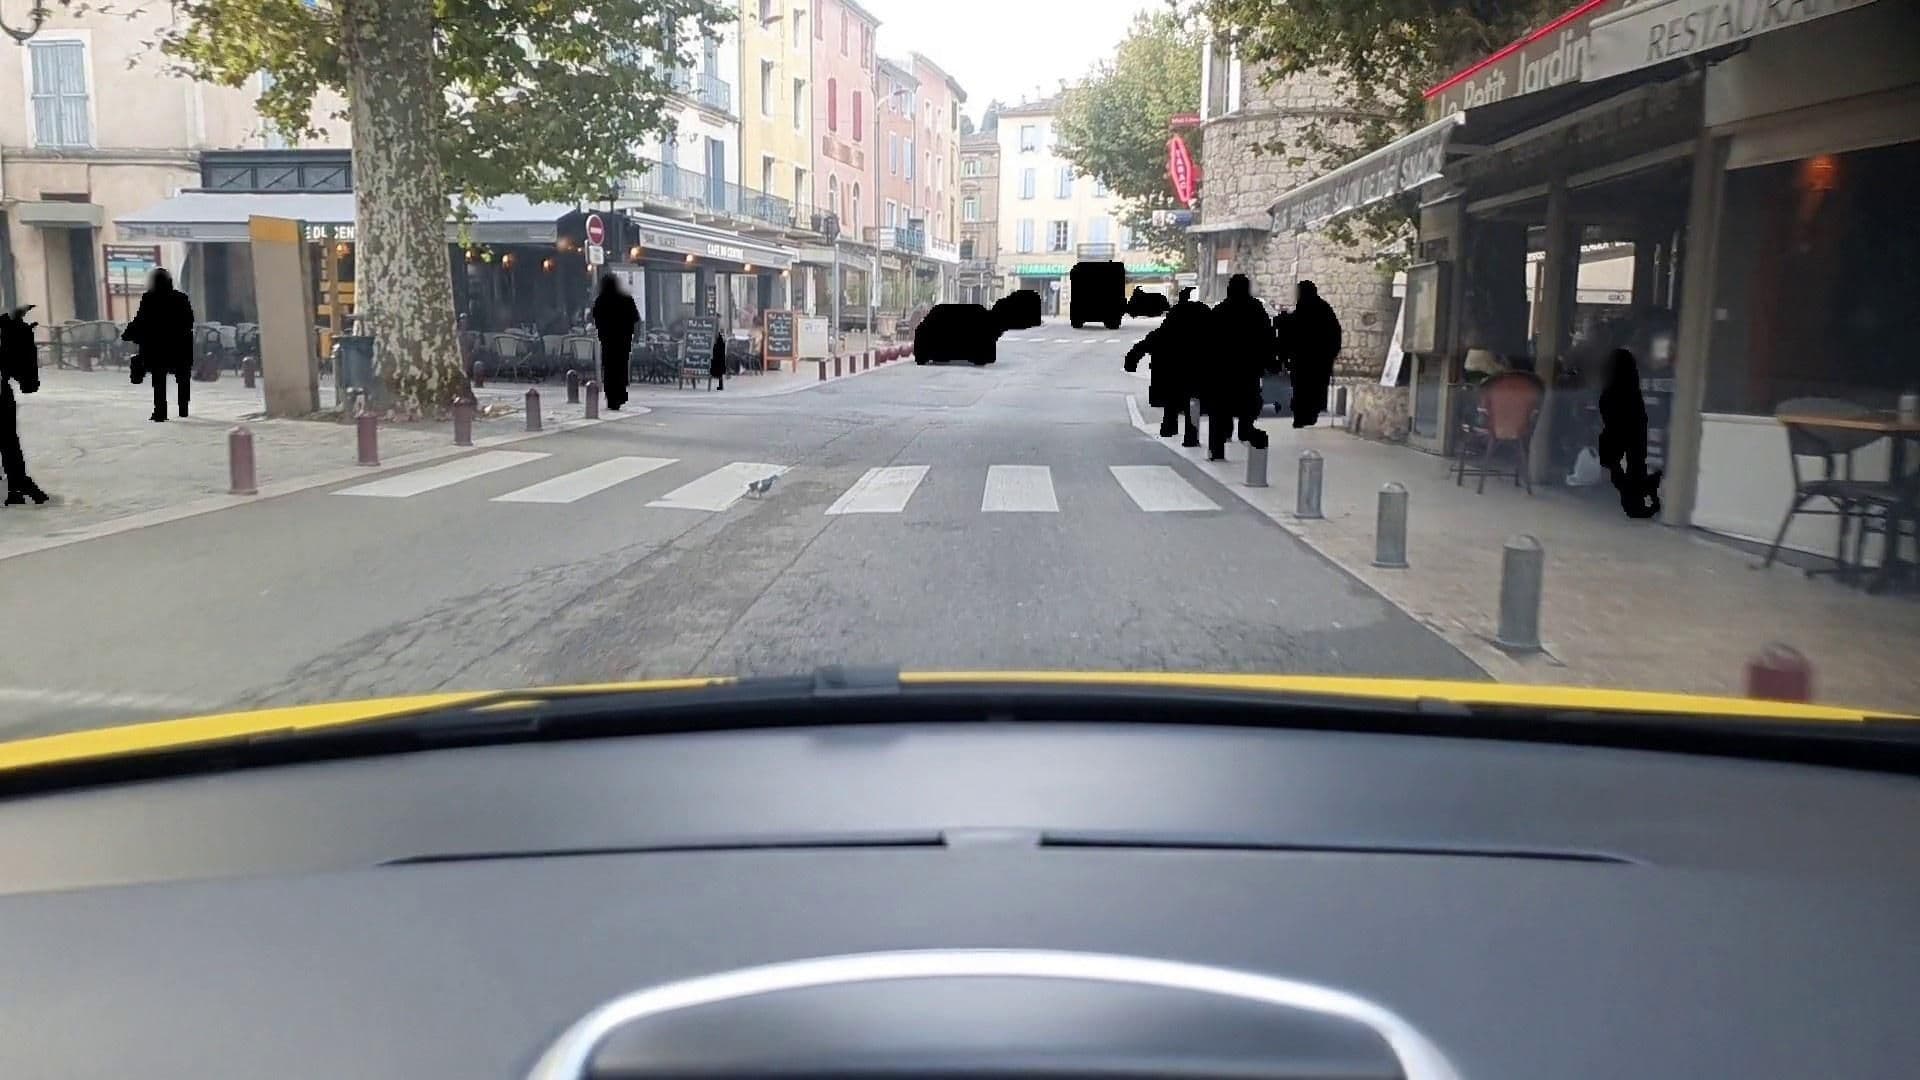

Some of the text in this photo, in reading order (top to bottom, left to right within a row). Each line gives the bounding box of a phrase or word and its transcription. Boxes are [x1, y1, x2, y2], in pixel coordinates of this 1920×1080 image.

[1463, 68, 1507, 109] Petit
[1513, 29, 1590, 97] Jardin
[1175, 148, 1187, 190] TABAC
